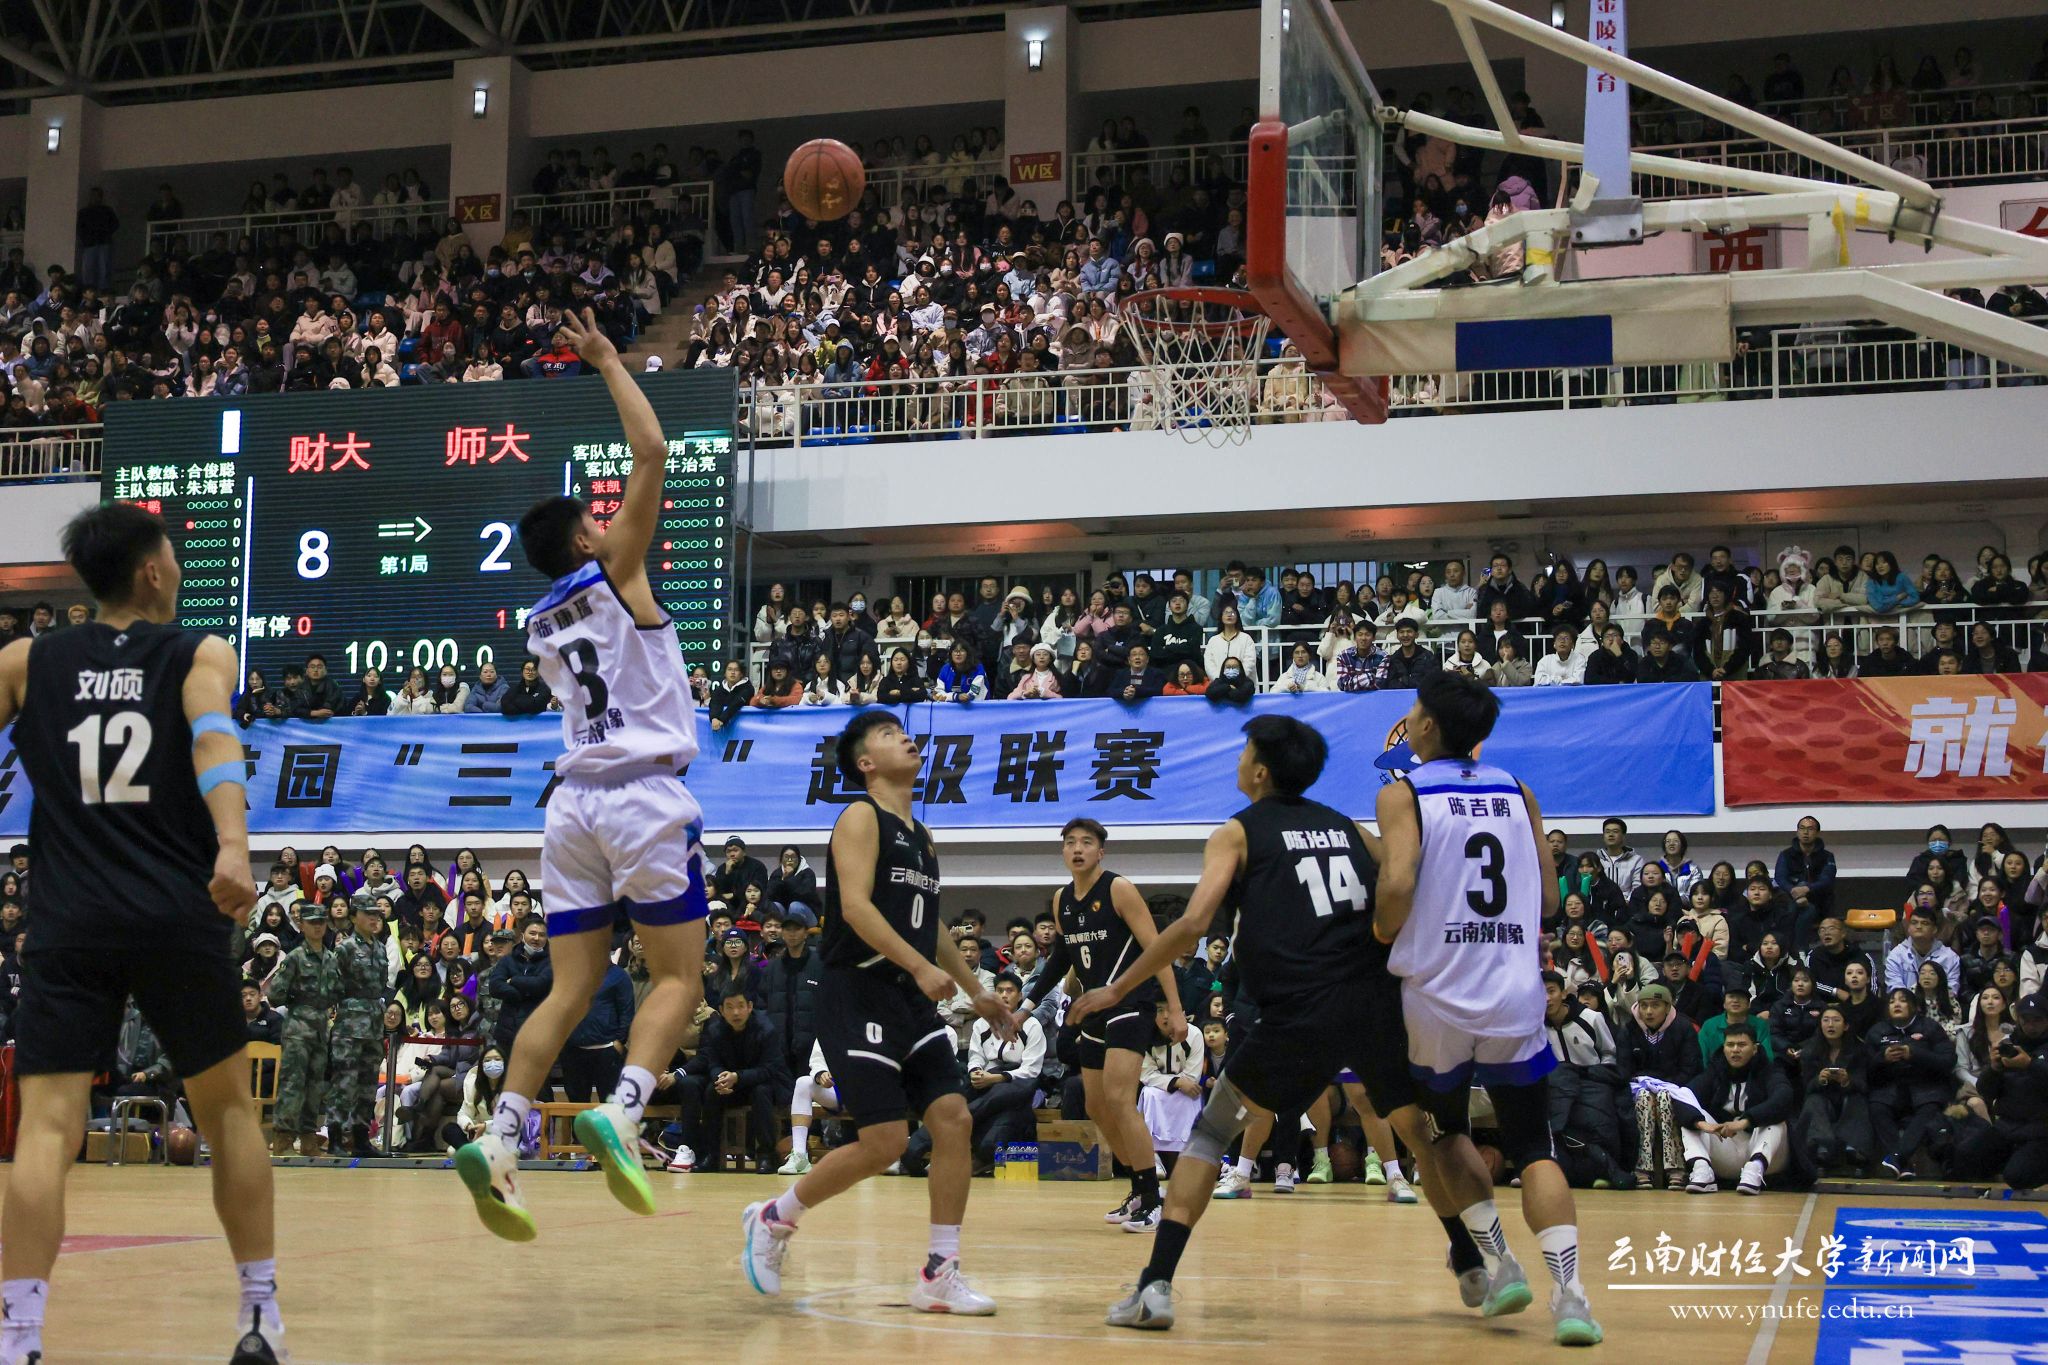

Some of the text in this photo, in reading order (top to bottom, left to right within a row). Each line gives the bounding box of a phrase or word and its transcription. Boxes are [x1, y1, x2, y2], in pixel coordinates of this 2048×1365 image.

[1596, 0, 1617, 93] 金陵育
[1017, 163, 1054, 180] W区
[463, 204, 493, 220] X区
[288, 432, 371, 473] 财大
[445, 424, 530, 466] 师大
[573, 476, 725, 494] 6 张凯 0
[234, 498, 242, 508] 0
[591, 496, 725, 514] 黄夕 0
[233, 518, 241, 528] 0
[715, 516, 724, 527] 0
[232, 537, 240, 547] 0
[479, 522, 512, 571] 2
[715, 537, 723, 548] 0
[231, 557, 239, 567] 0
[297, 530, 330, 579] 8
[714, 558, 723, 569] 0
[380, 555, 429, 575] 第1局
[231, 577, 239, 587] 0
[714, 578, 723, 589] 0
[230, 596, 238, 606] 0
[713, 599, 722, 610] 0
[229, 615, 237, 626] 0
[247, 615, 312, 638] 暂停 0
[496, 610, 506, 629] 1
[713, 619, 721, 630] 0
[228, 635, 236, 645] 0
[712, 639, 721, 650] 0
[345, 638, 494, 674] 10:00.0
[712, 661, 720, 672] 0
[74, 668, 144, 701] 刘硕
[559, 638, 609, 720] 8
[1904, 695, 2048, 779] 就
[67, 711, 153, 804] 12
[1464, 831, 1508, 918] 3
[1294, 855, 1368, 917] 14
[911, 893, 925, 929] 0
[1080, 945, 1092, 969] 6
[866, 1021, 883, 1044] 0
